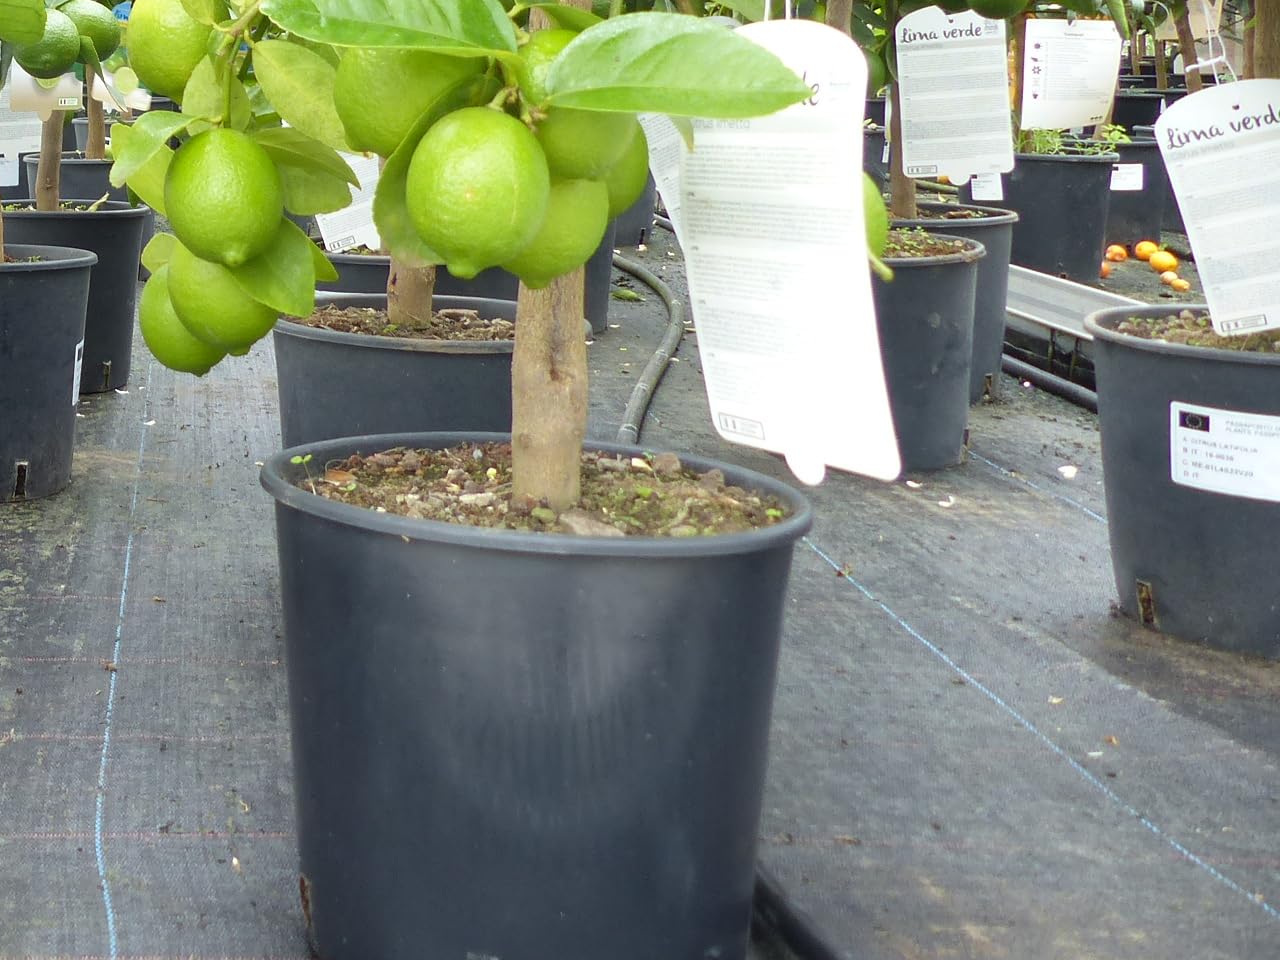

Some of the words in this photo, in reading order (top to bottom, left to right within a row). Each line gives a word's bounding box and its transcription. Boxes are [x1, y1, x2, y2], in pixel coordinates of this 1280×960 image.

[900, 27, 939, 44] Lima
[943, 22, 983, 39] verde
[1166, 125, 1225, 150] Lima
[1229, 103, 1280, 133] verd
